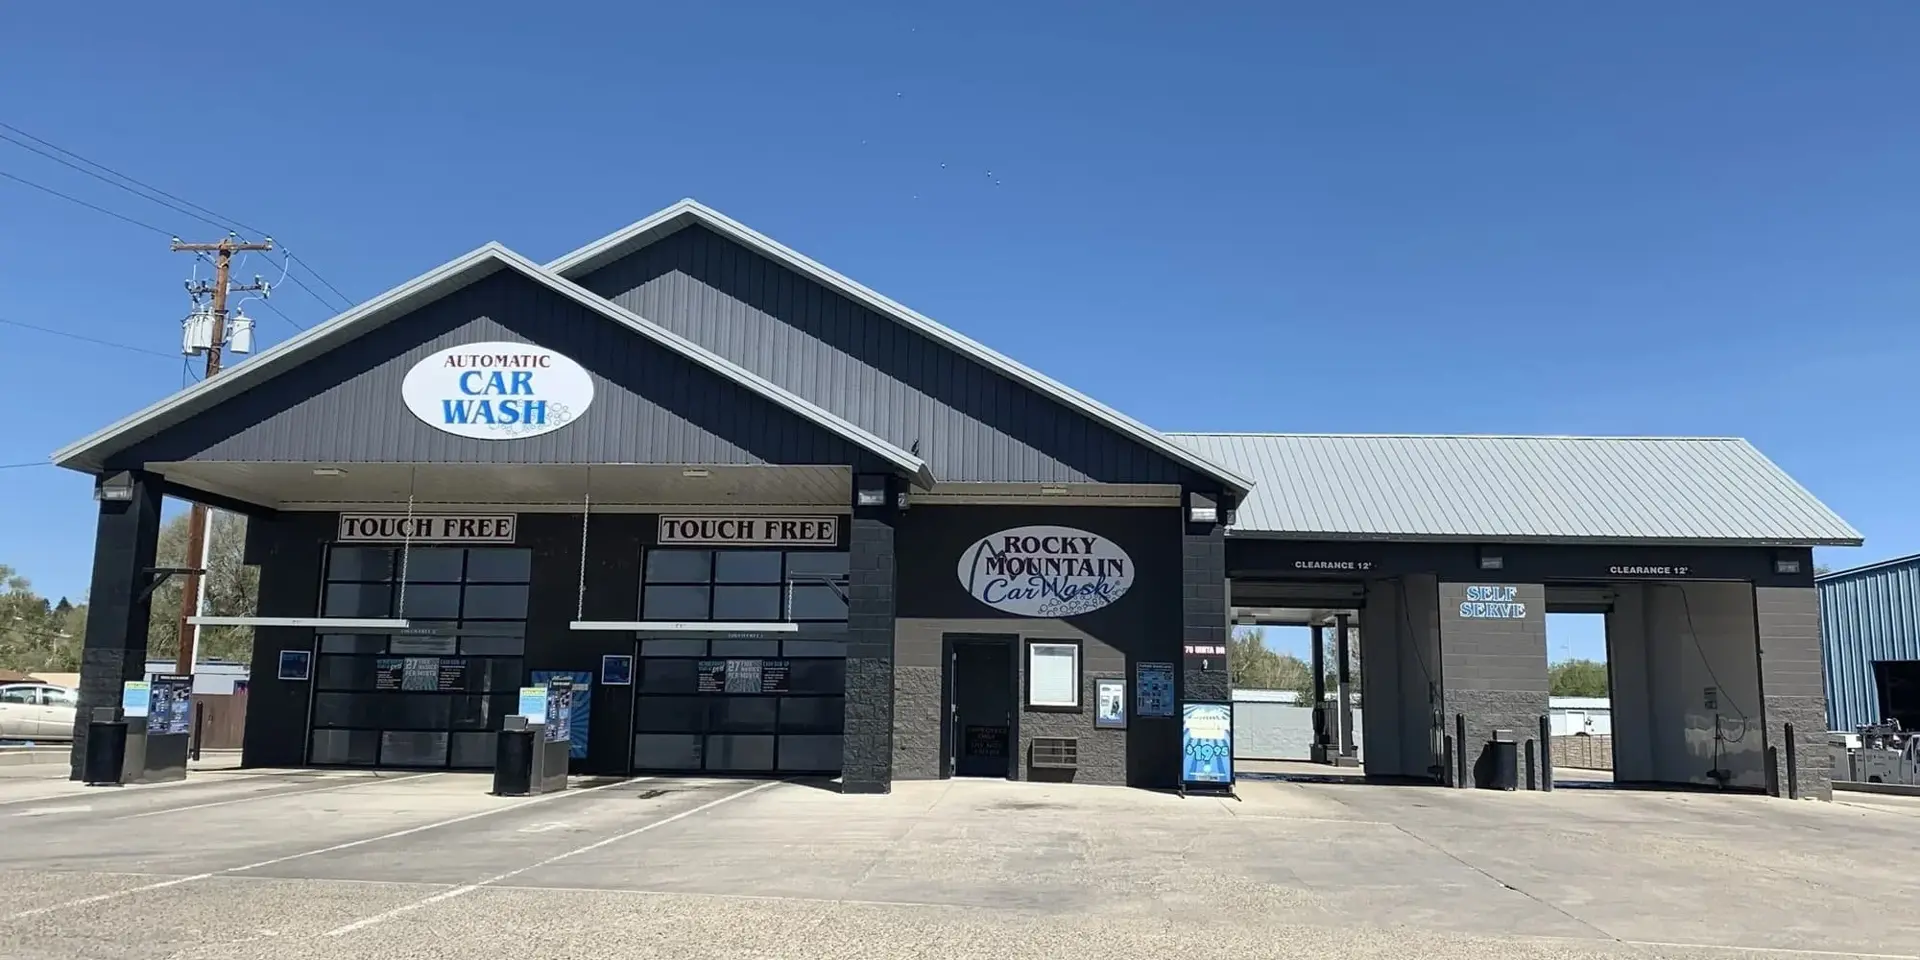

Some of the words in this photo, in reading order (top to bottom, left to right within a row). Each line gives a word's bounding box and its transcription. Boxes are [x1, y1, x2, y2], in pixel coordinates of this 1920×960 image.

[444, 354, 551, 368] AUTOMATIC
[459, 370, 535, 396] CAR
[441, 399, 548, 425] WASH
[344, 518, 436, 538] TOUCH
[443, 518, 513, 539] FREE
[663, 520, 755, 541] TOUCH
[765, 520, 834, 542] FREE
[1004, 536, 1098, 554] ROCKY
[985, 557, 1125, 577] MOUNTAIN
[1294, 560, 1355, 569] CLEARANCE
[1357, 561, 1372, 570] 12'
[1609, 565, 1672, 575] CLEARANCE
[1674, 566, 1688, 575] 12'
[983, 578, 1037, 604] Car
[1029, 573, 1114, 599] Wash
[1466, 585, 1518, 602] SELF
[1459, 601, 1527, 618] SERVE
